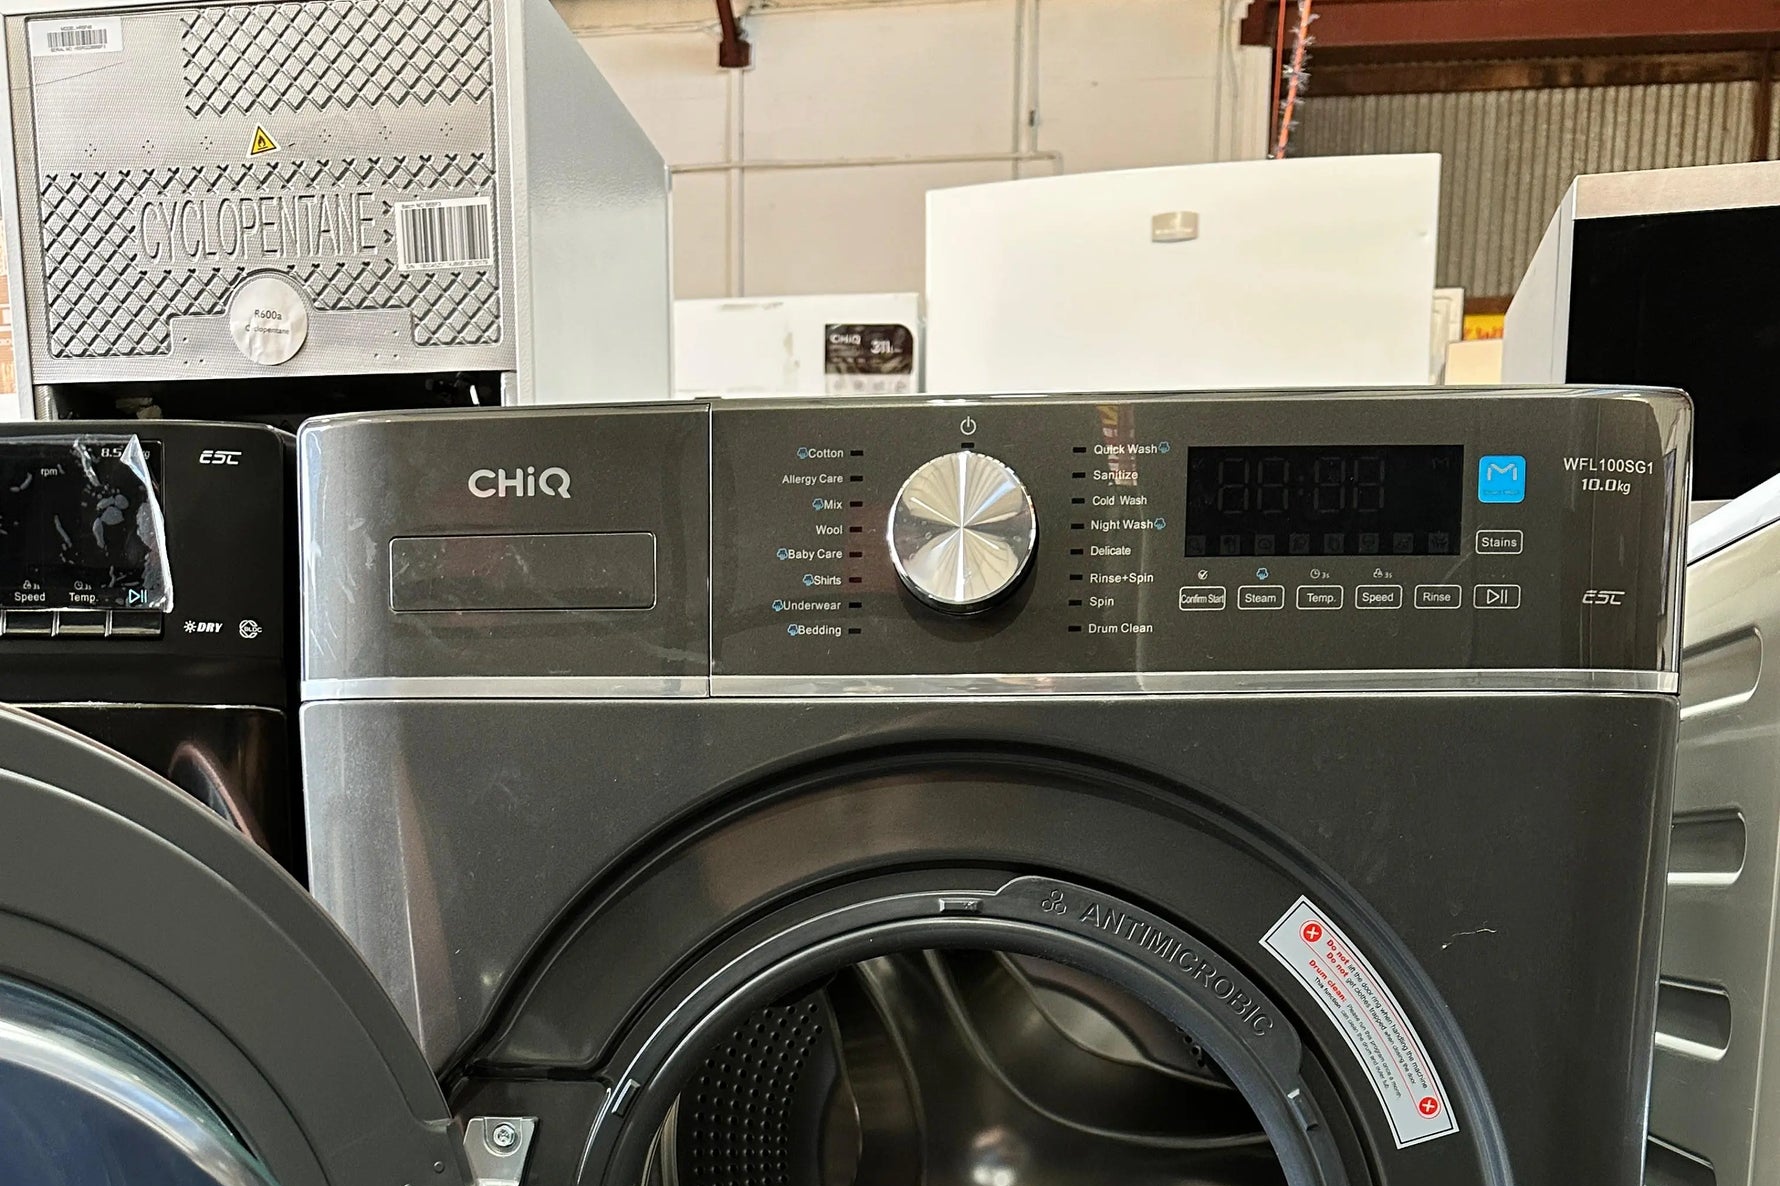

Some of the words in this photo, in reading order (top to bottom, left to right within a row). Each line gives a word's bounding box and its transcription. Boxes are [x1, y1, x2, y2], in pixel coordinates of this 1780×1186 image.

[141, 192, 378, 264] CYCLOPENTANE
[808, 449, 844, 458] Cotton
[1094, 444, 1125, 454] Quick
[1128, 444, 1158, 454] Wash
[1563, 457, 1654, 475] WFL100SG1
[41, 467, 58, 479] rpm
[1093, 470, 1138, 480] Sanitize
[468, 466, 571, 499] CHiQ
[782, 474, 817, 486] Allergy
[819, 474, 843, 483] Care
[824, 500, 843, 509] Mix
[1093, 496, 1115, 506] Cold
[1120, 495, 1147, 505] Wash
[816, 525, 843, 535] Wool
[1091, 520, 1120, 532] Night
[1123, 520, 1153, 529] Wash
[1481, 537, 1518, 547] Stains
[788, 549, 815, 560] Baby
[817, 549, 843, 559] Care
[1090, 546, 1131, 556] Delicate
[813, 575, 842, 585] Shirts
[1090, 573, 1154, 585] Rinse+Spin
[14, 592, 46, 602] Speed
[1090, 596, 1114, 608] Spin
[1244, 593, 1277, 603] Steam
[1362, 592, 1394, 603] Speed
[1423, 592, 1452, 602] Rinse
[783, 601, 841, 610] Underwear
[197, 622, 223, 633] DRY
[798, 625, 842, 637] Bedding
[1089, 624, 1118, 633] Drum
[1121, 623, 1153, 633] Clean
[1079, 901, 1274, 1037] ANTIMICROBIC
[1309, 960, 1328, 980] Drum
[1327, 980, 1347, 1002] clean:
[1327, 952, 1336, 963] Do
[1336, 964, 1349, 977] not
[1355, 987, 1371, 1008] clothes
[1369, 1007, 1387, 1031] trapped
[1324, 987, 1341, 1009] function
[1327, 939, 1337, 951] Do
[1337, 951, 1350, 965] not
[1354, 972, 1362, 983] the
[1362, 983, 1373, 995] door
[1372, 996, 1381, 1009] ring
[1380, 1008, 1393, 1025] when
[1406, 1050, 1414, 1062] the
[1412, 1062, 1427, 1088] machine
